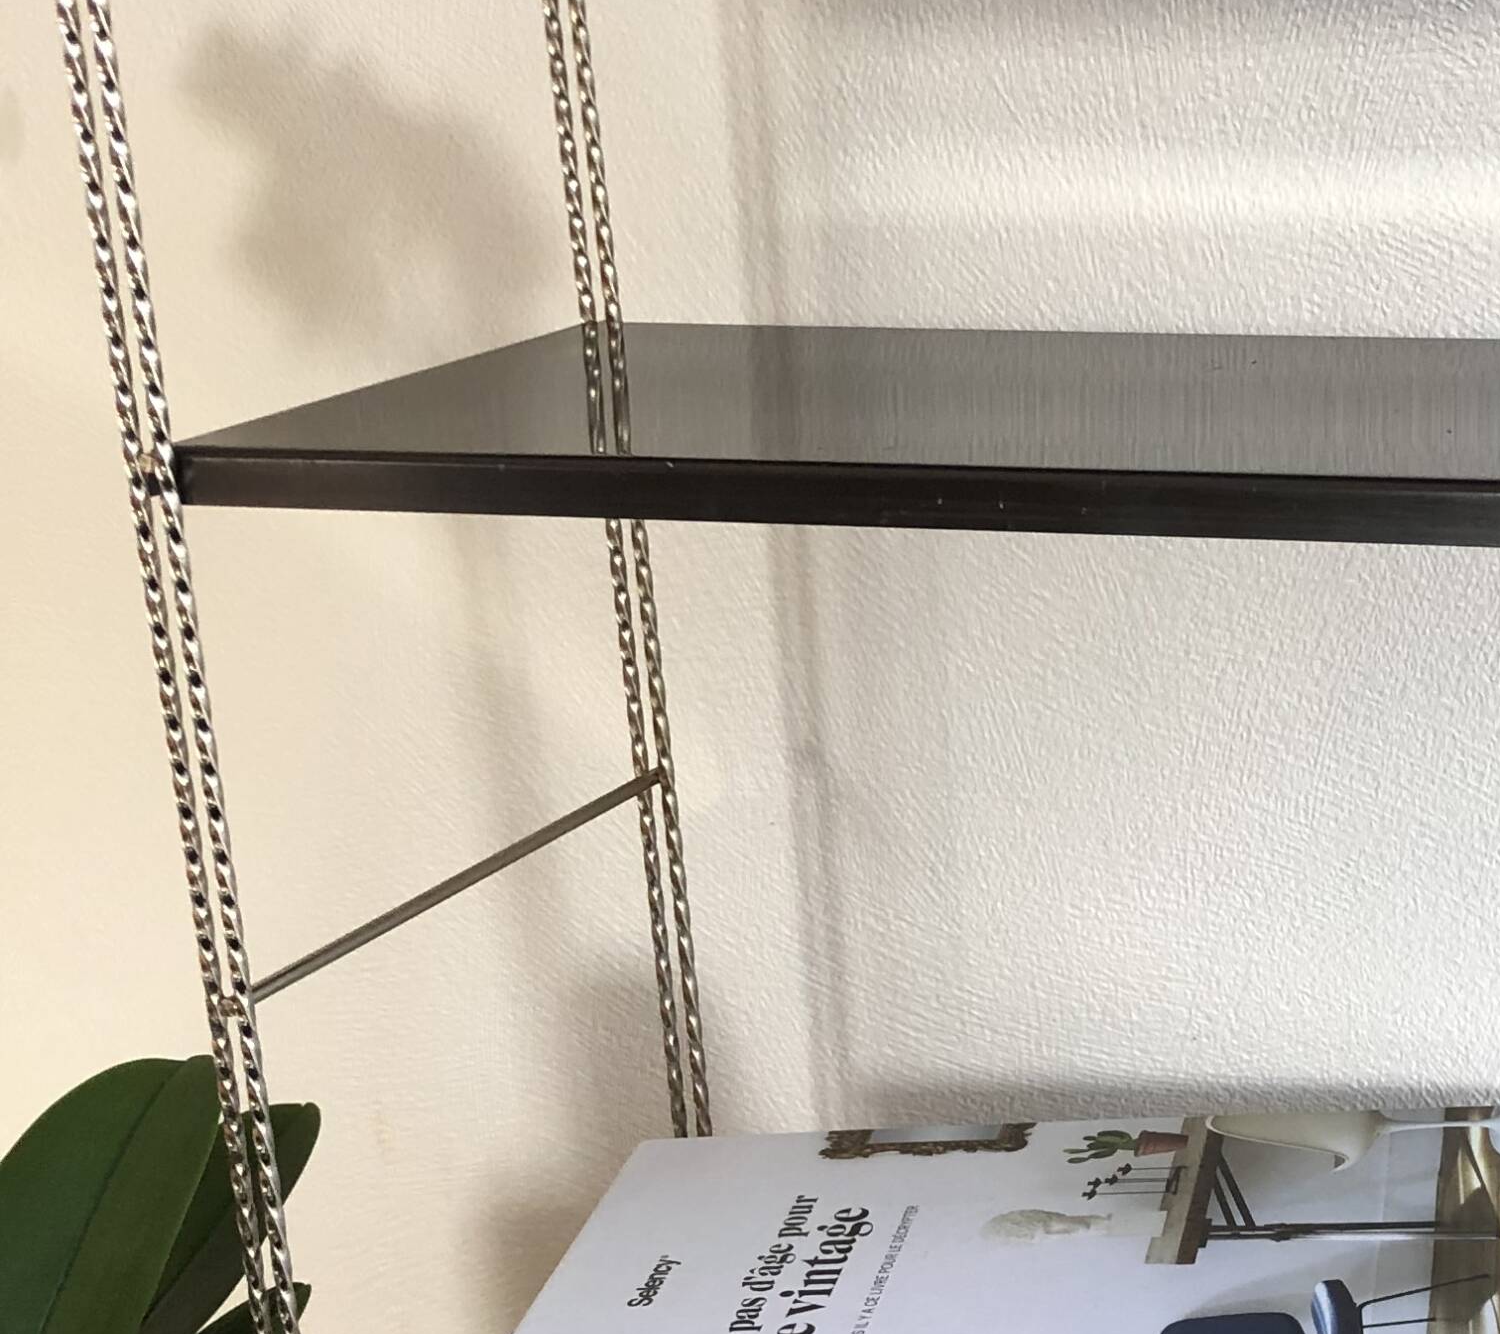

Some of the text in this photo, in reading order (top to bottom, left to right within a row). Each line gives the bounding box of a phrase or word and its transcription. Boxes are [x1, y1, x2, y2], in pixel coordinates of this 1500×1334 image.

[778, 1194, 819, 1238] pour
[627, 1254, 682, 1307] Selency
[742, 1242, 797, 1292] d'âge
[779, 1206, 874, 1318] vintage
[729, 1296, 767, 1333] pas
